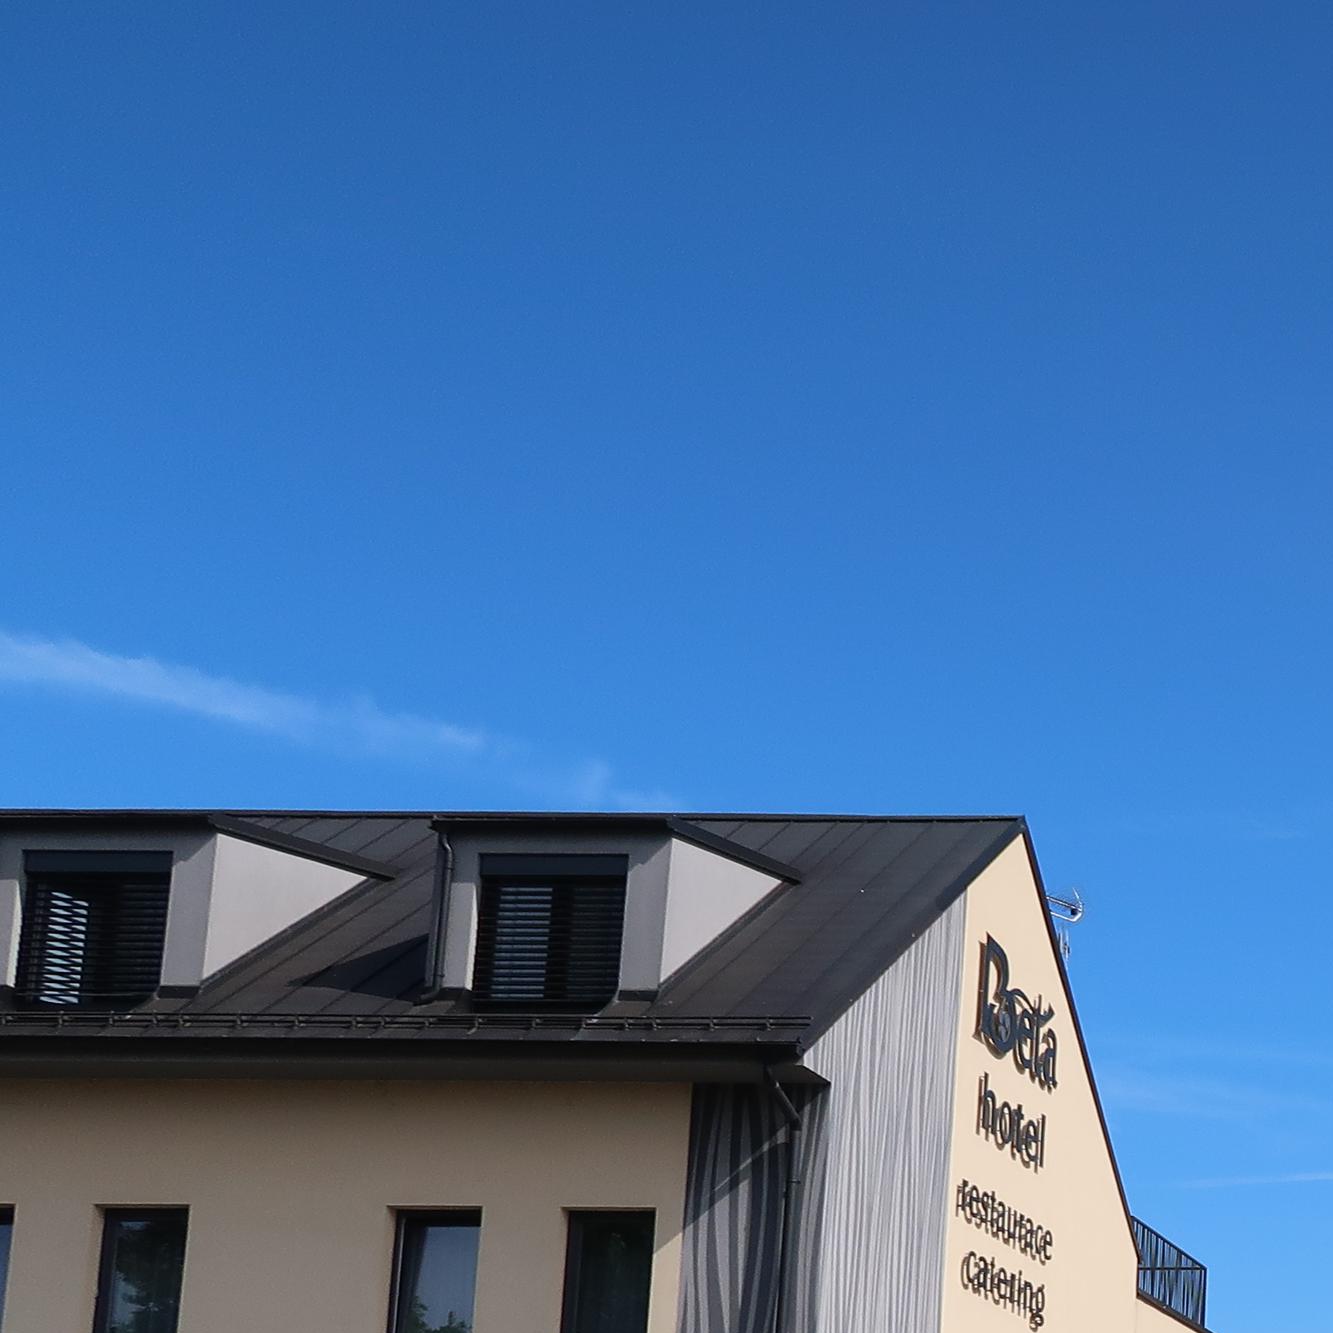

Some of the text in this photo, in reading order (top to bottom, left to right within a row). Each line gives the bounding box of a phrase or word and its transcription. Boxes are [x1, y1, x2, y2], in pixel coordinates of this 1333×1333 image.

[975, 932, 1057, 1090] Beta
[979, 1072, 1045, 1170] hotel
[959, 1179, 1053, 1261] restaurace
[963, 1249, 1046, 1326] catering
